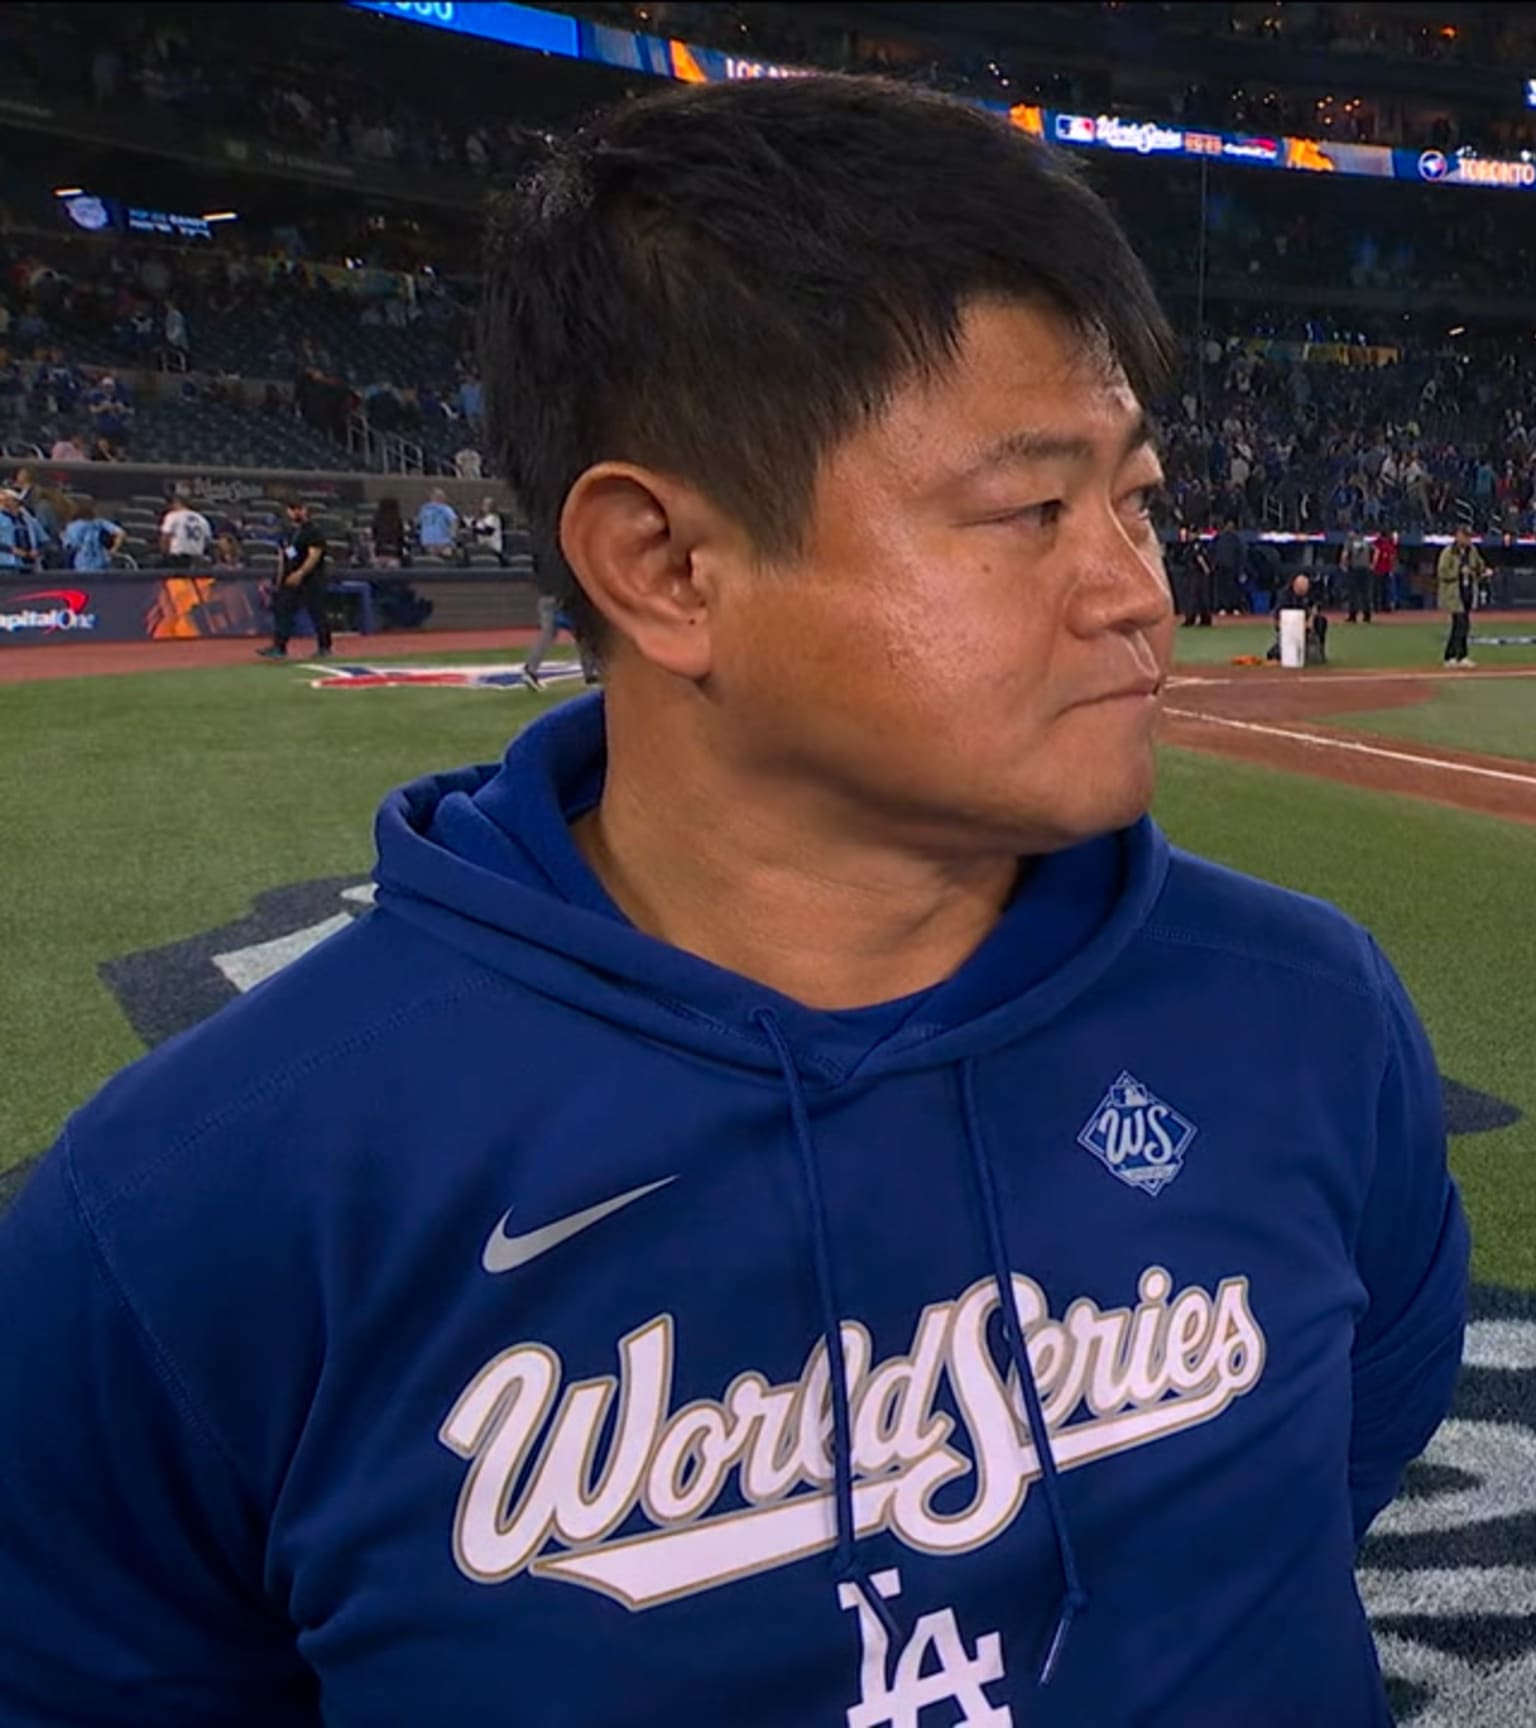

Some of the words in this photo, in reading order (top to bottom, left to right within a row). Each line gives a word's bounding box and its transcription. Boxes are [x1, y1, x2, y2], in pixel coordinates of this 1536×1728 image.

[1457, 158, 1536, 185] TORONTO
[1098, 1105, 1172, 1165] WS
[437, 1300, 948, 1584] World
[888, 1265, 1268, 1556] Series
[837, 1568, 1013, 1728] LA
